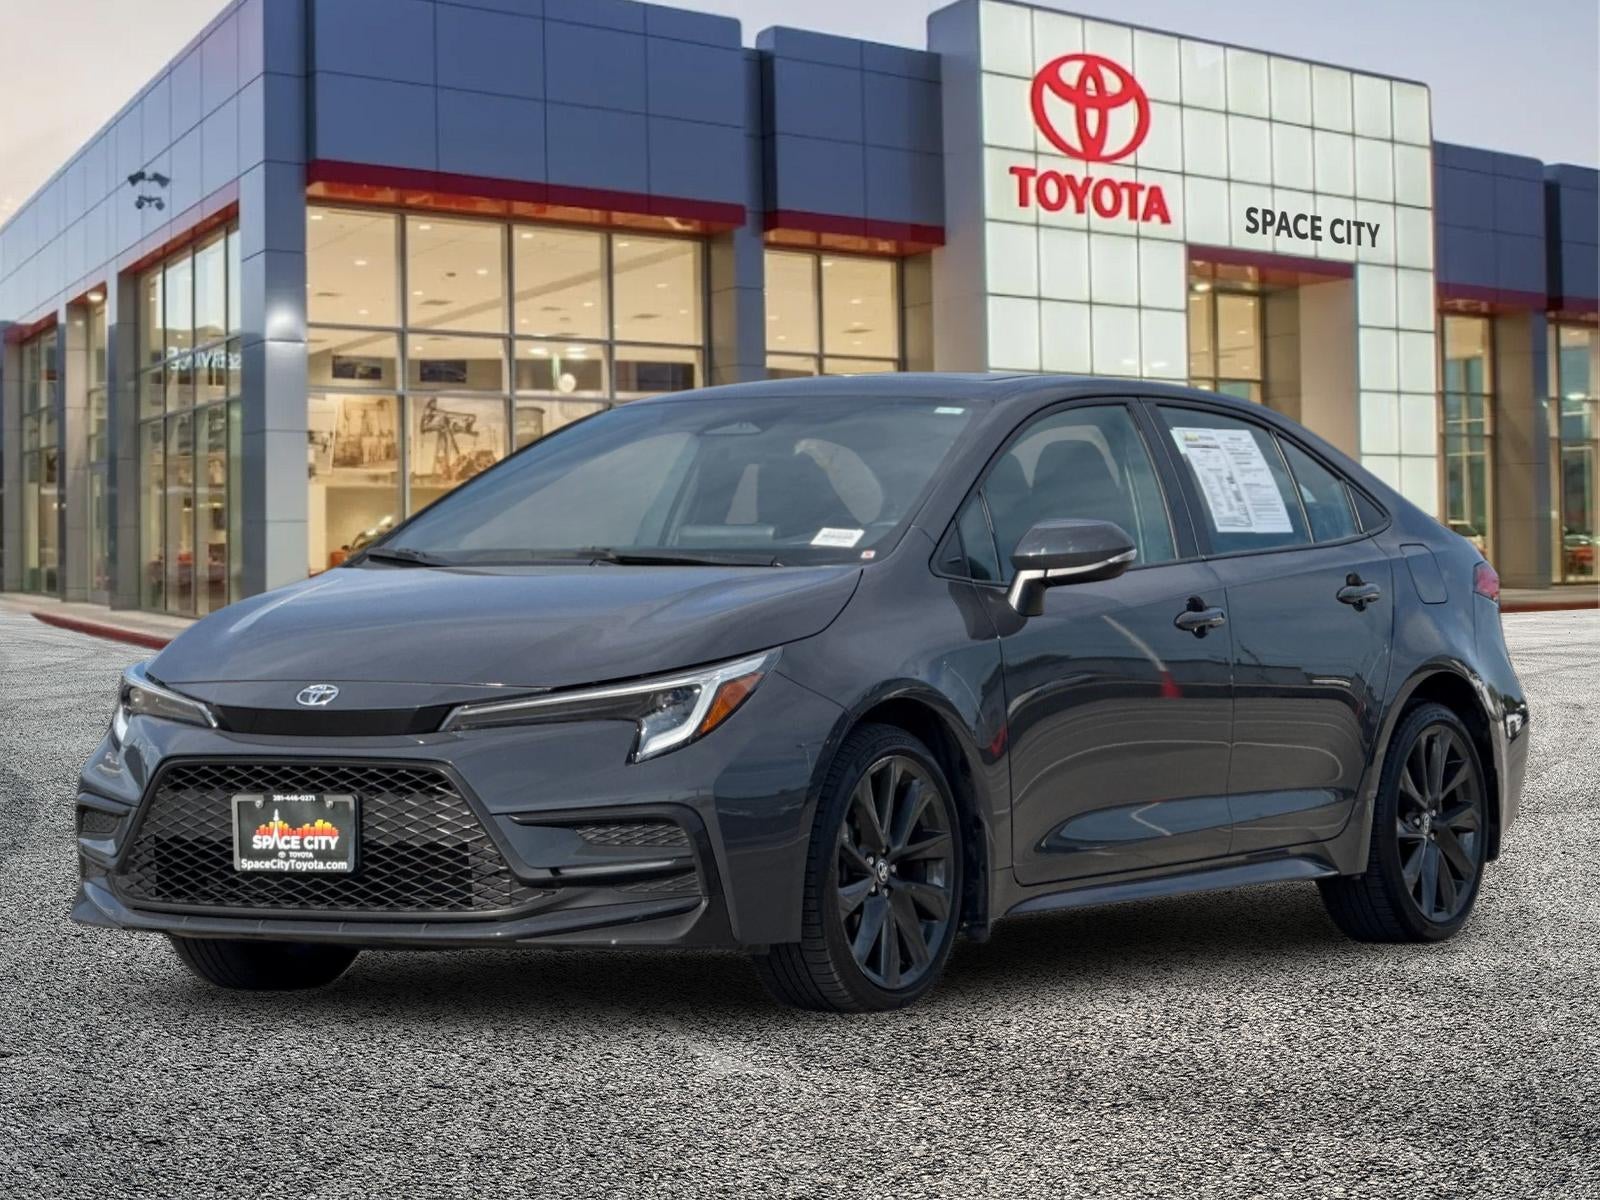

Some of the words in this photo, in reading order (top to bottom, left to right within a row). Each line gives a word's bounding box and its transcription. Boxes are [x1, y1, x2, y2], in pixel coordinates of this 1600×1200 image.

[1009, 166, 1171, 225] TOYOTA
[1245, 206, 1322, 242] SPACE
[1330, 217, 1380, 248] CITY
[252, 834, 301, 850] SPACE
[303, 835, 340, 850] CITY
[288, 851, 314, 859] TOYOTA
[241, 859, 348, 871] SpaceCityToyota.com
